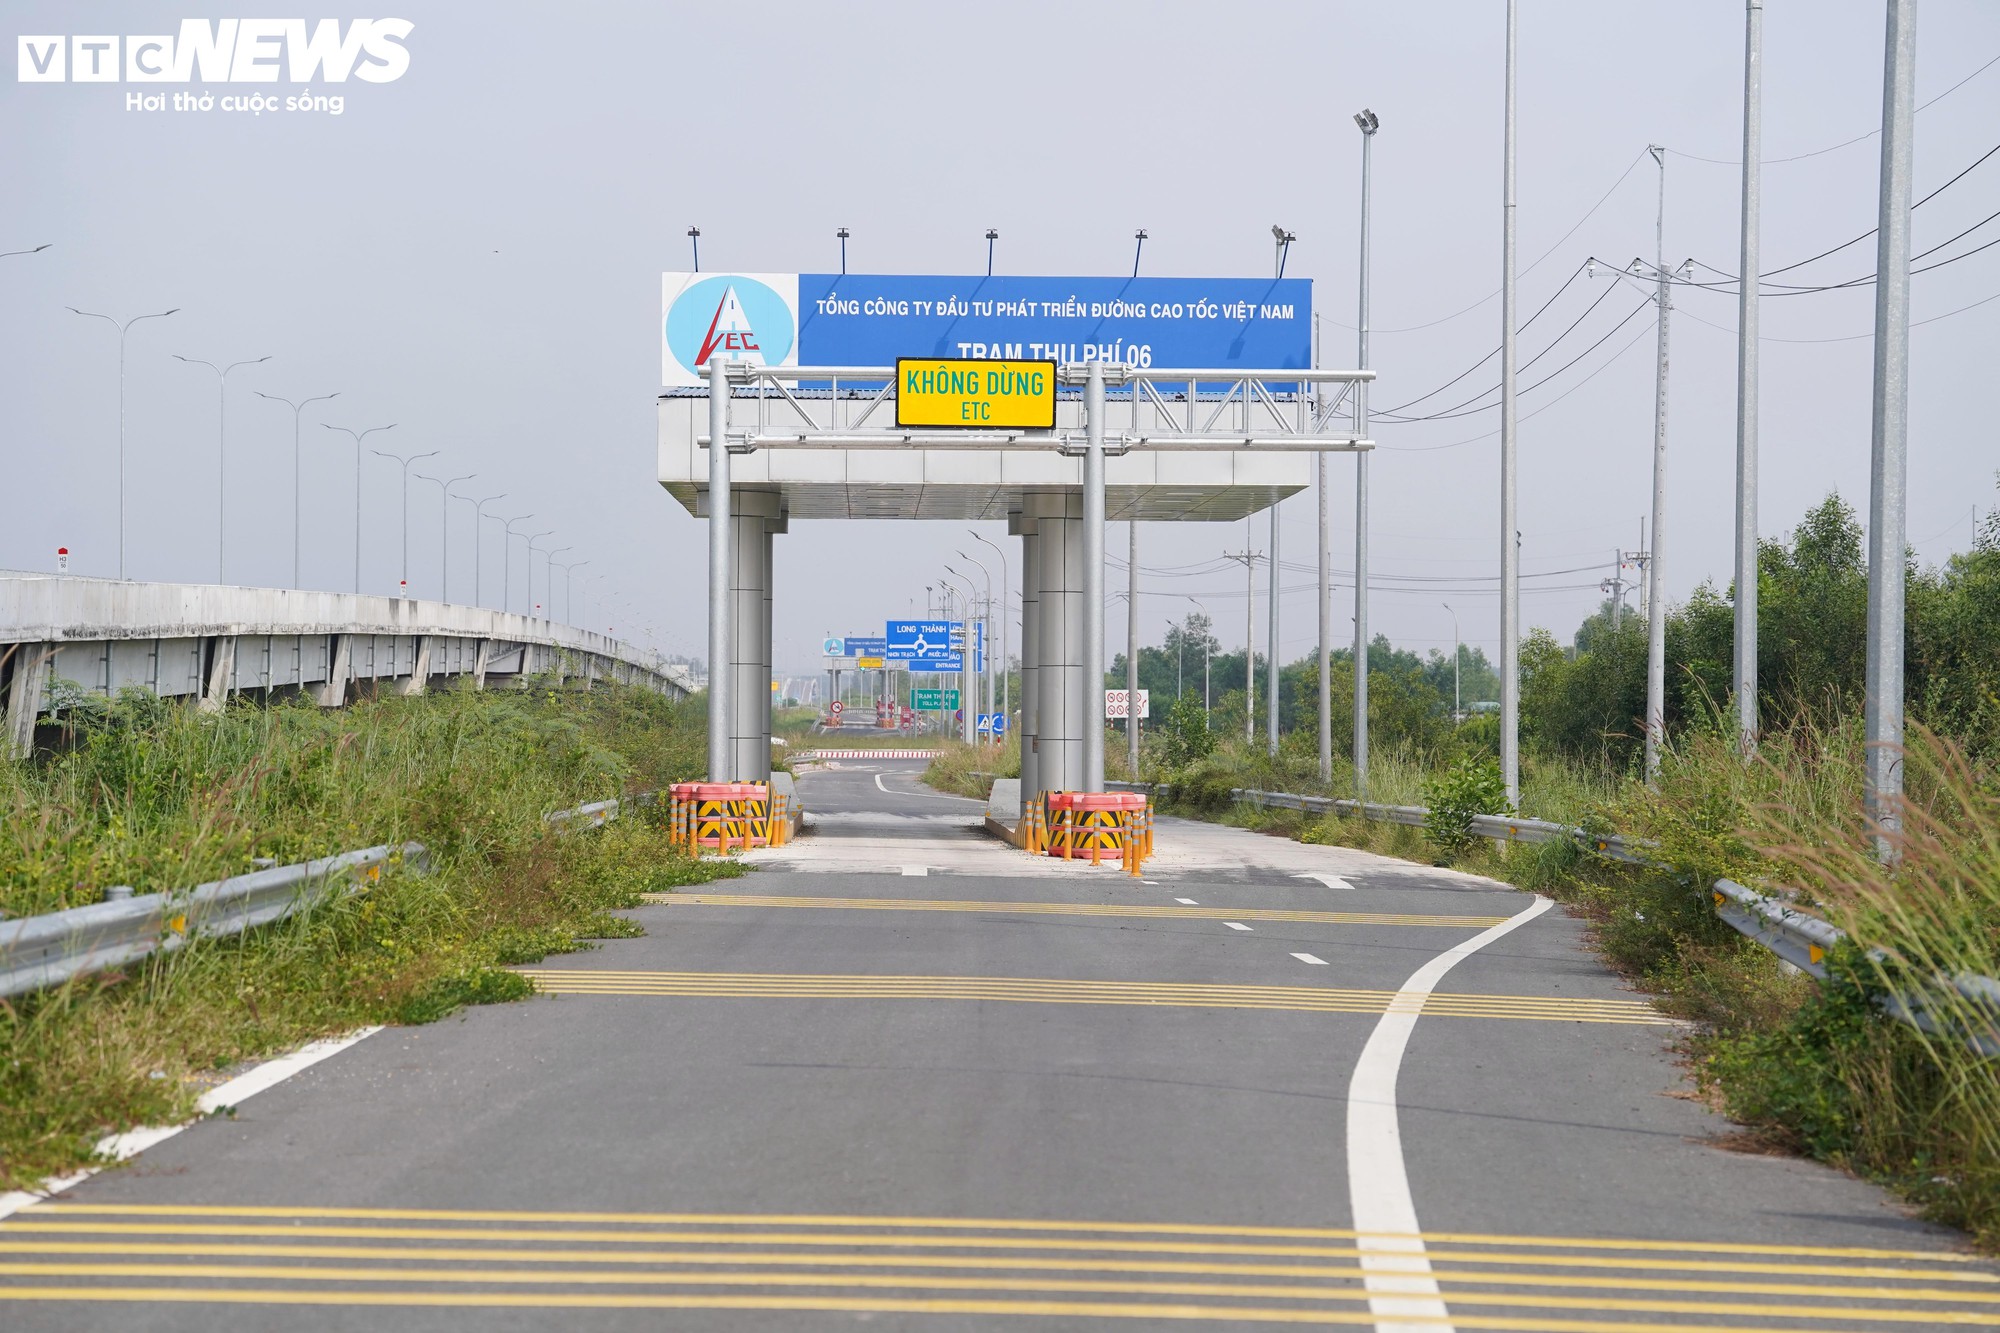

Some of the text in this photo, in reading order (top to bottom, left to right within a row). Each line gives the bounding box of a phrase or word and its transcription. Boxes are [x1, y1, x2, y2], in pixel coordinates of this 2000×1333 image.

[817, 292, 1294, 322] TỔNG CÔNG TY ĐẦU TƯ PHÁT TRIỂN ĐƯỜNG CAO TỐC VIỆT NAM
[1029, 343, 1075, 364] THU
[1083, 338, 1122, 364] PHÍ
[1127, 345, 1152, 369] 06
[907, 365, 1044, 396] KHÔNG DỪNG
[962, 402, 991, 420] ETC
[896, 625, 917, 633] LONG
[920, 624, 947, 633] THÀNH
